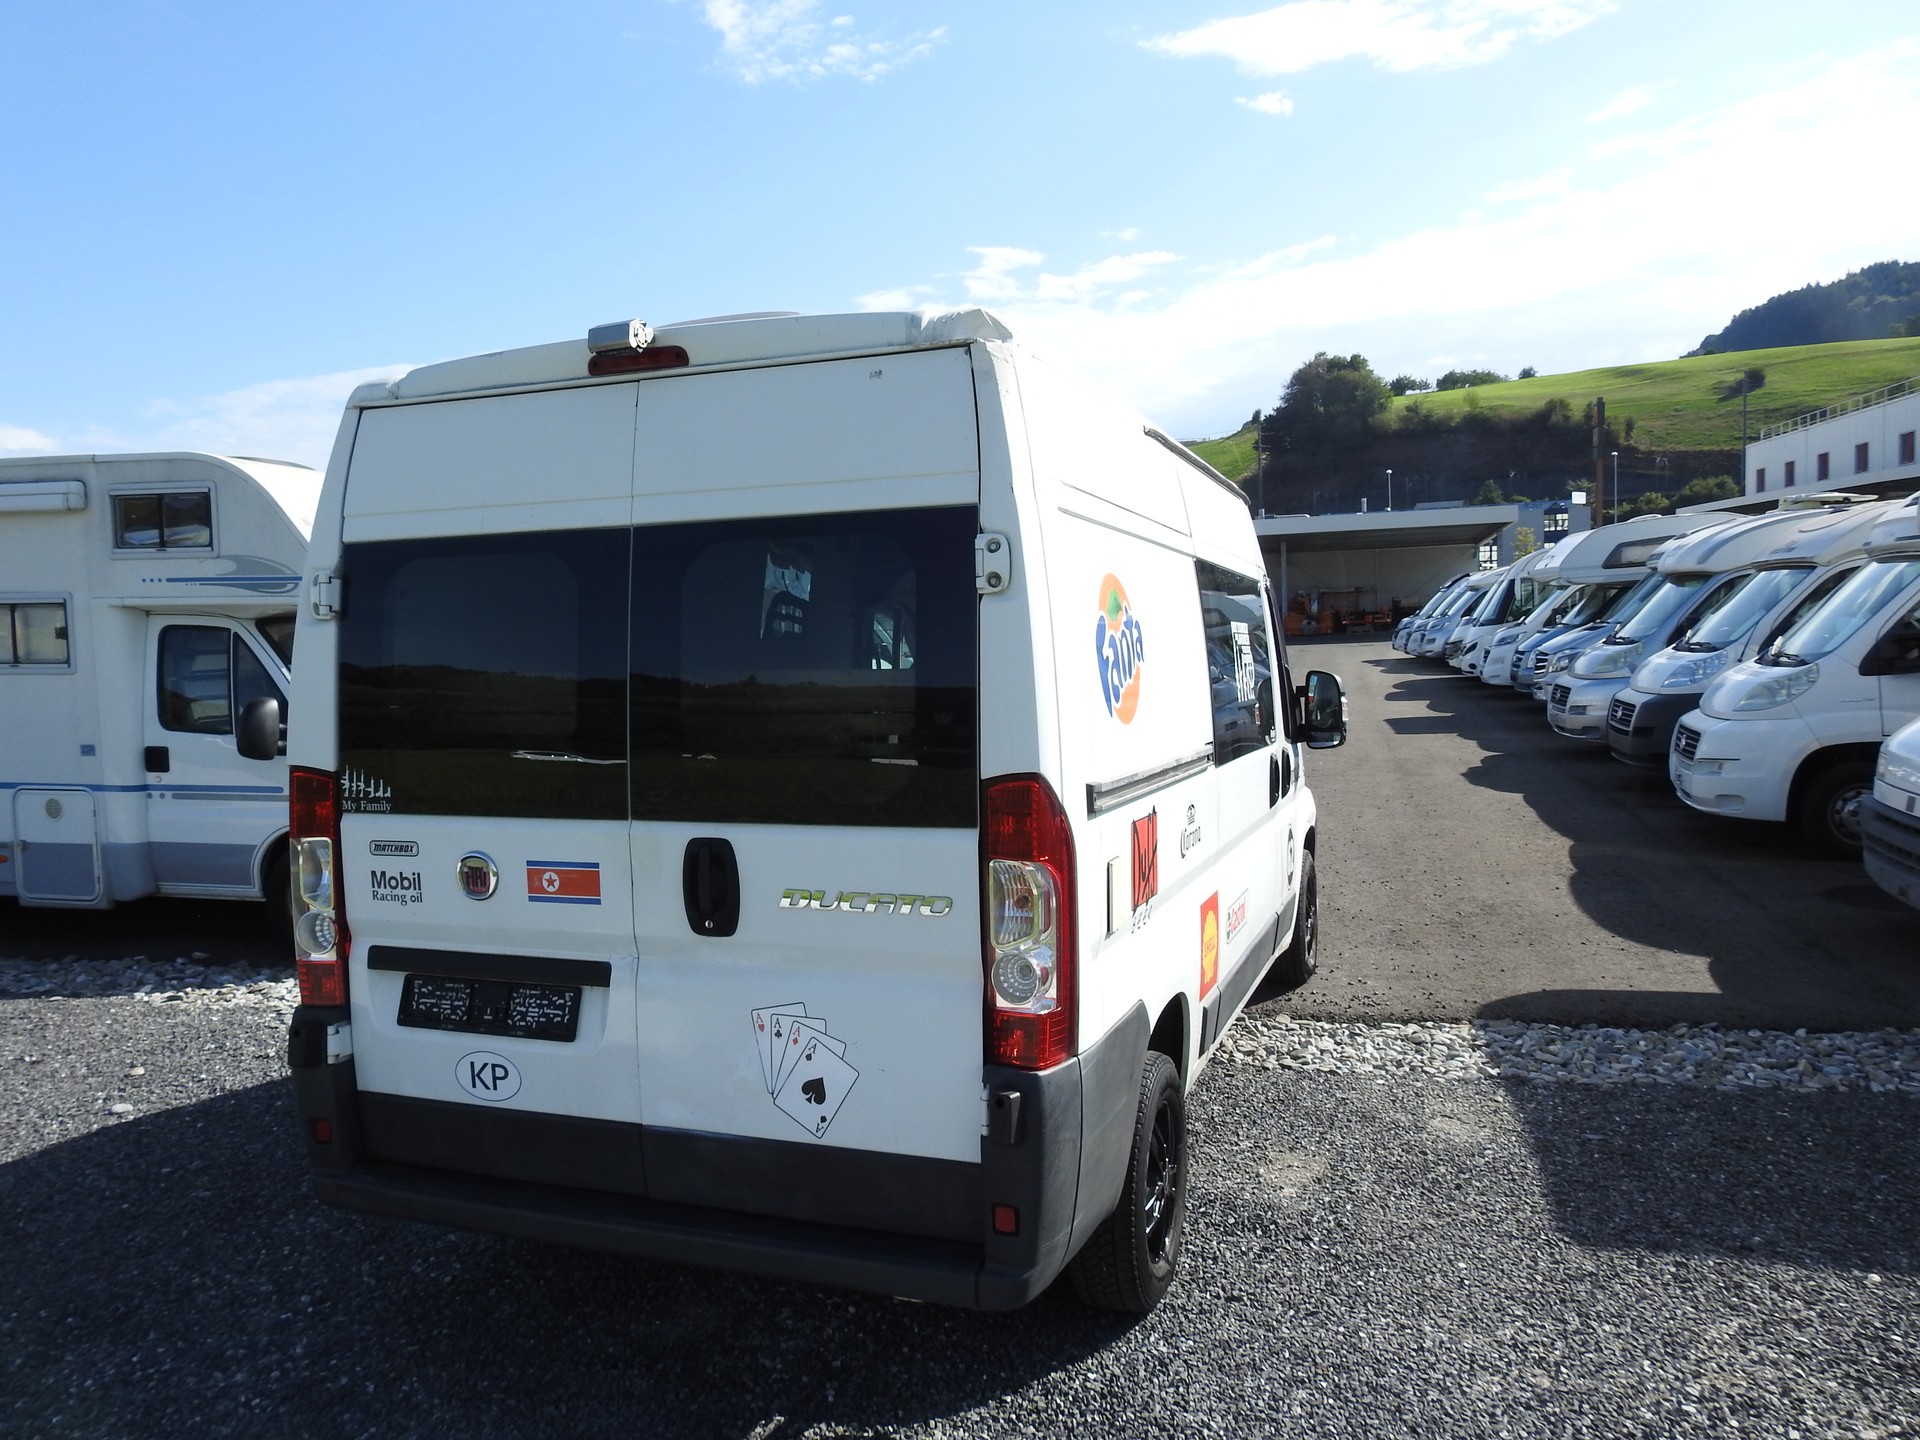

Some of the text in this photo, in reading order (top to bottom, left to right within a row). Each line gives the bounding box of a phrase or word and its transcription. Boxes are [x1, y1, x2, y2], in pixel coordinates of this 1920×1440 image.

[1096, 605, 1145, 718] Fanta
[342, 801, 392, 813] My Family
[371, 870, 422, 891] Mobil
[372, 890, 423, 906] Racing oil
[779, 888, 953, 917] DUCATO
[756, 1013, 764, 1024] A
[773, 1017, 782, 1029] A
[793, 1026, 801, 1037] A
[808, 1043, 817, 1054] A
[470, 1061, 509, 1091] KP
